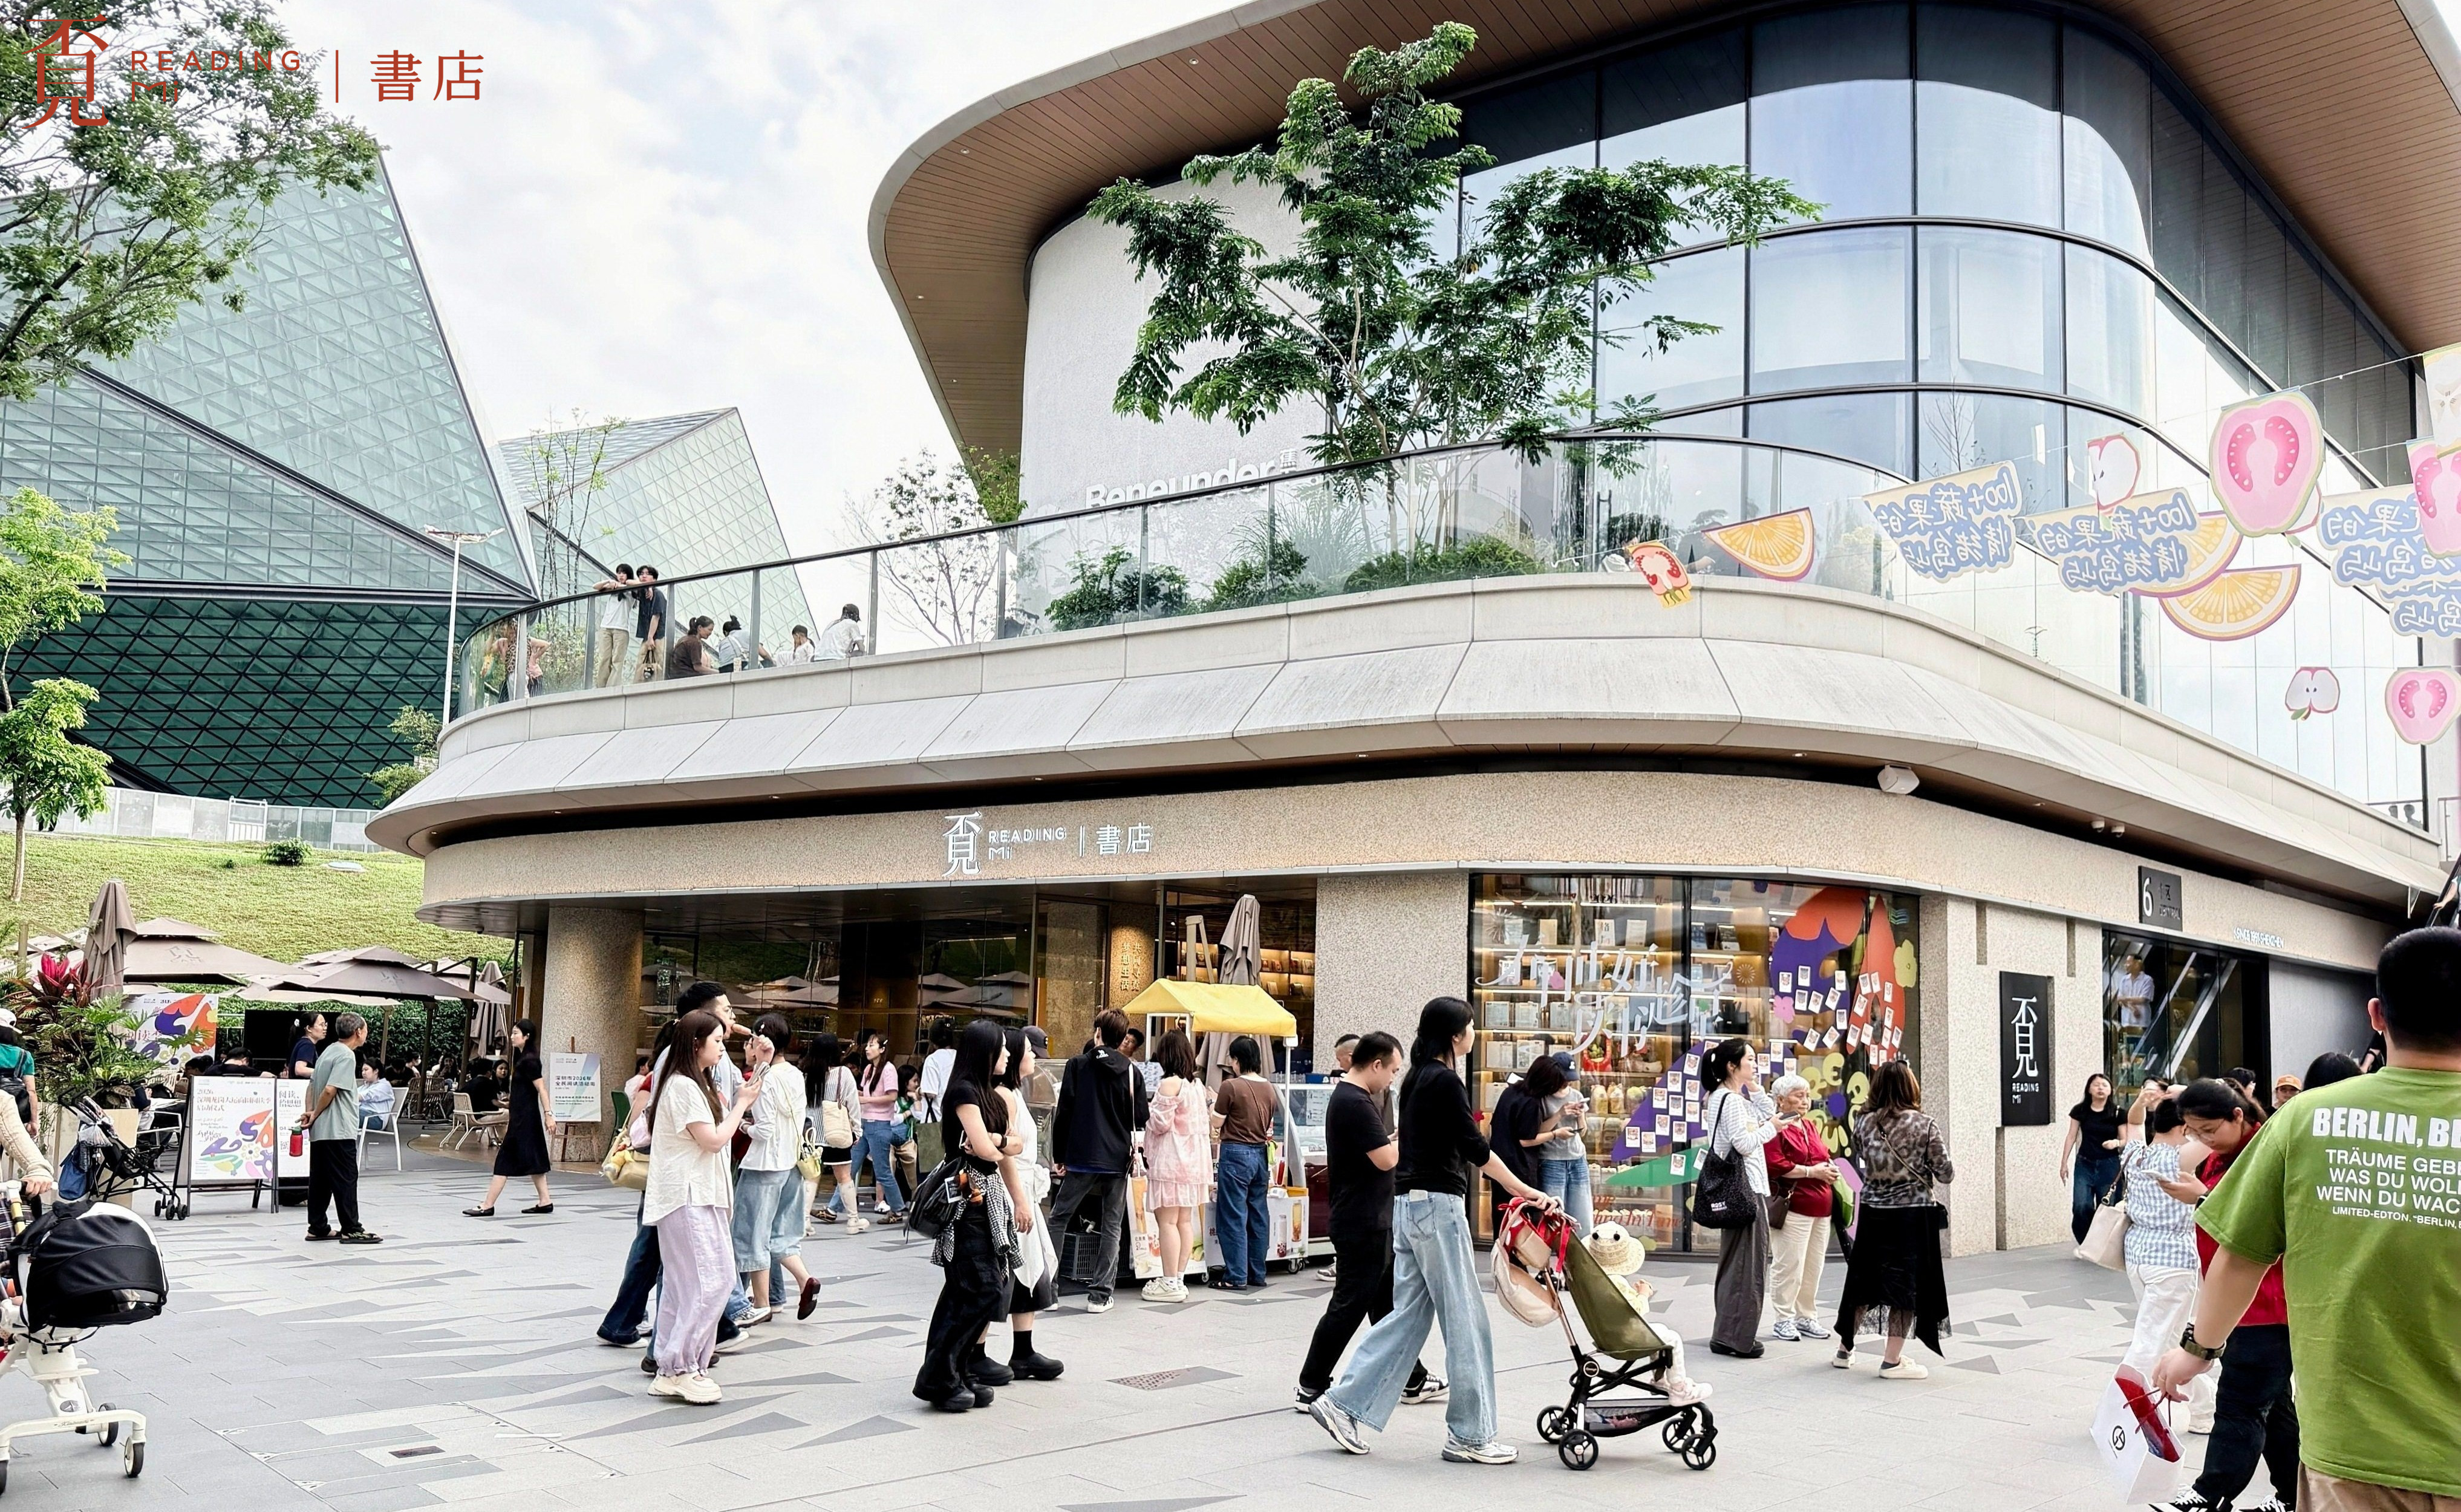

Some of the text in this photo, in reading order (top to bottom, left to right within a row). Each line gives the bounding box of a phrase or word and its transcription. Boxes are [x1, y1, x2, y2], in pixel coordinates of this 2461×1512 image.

[1086, 458, 1276, 509] Beneunder
[988, 827, 1066, 844] READING
[1096, 822, 1153, 855] 書店
[988, 846, 1012, 860] Mi
[2143, 877, 2153, 917] 6
[2012, 1083, 2039, 1092] READING
[2012, 1095, 2021, 1104] Mi
[2312, 1107, 2423, 1148] BERLIN,
[2326, 1147, 2407, 1170] TRÄUME
[2329, 1167, 2370, 1185] WAS
[2376, 1171, 2405, 1188] DU
[2316, 1185, 2371, 1205] WENN
[2378, 1190, 2406, 1207] DU
